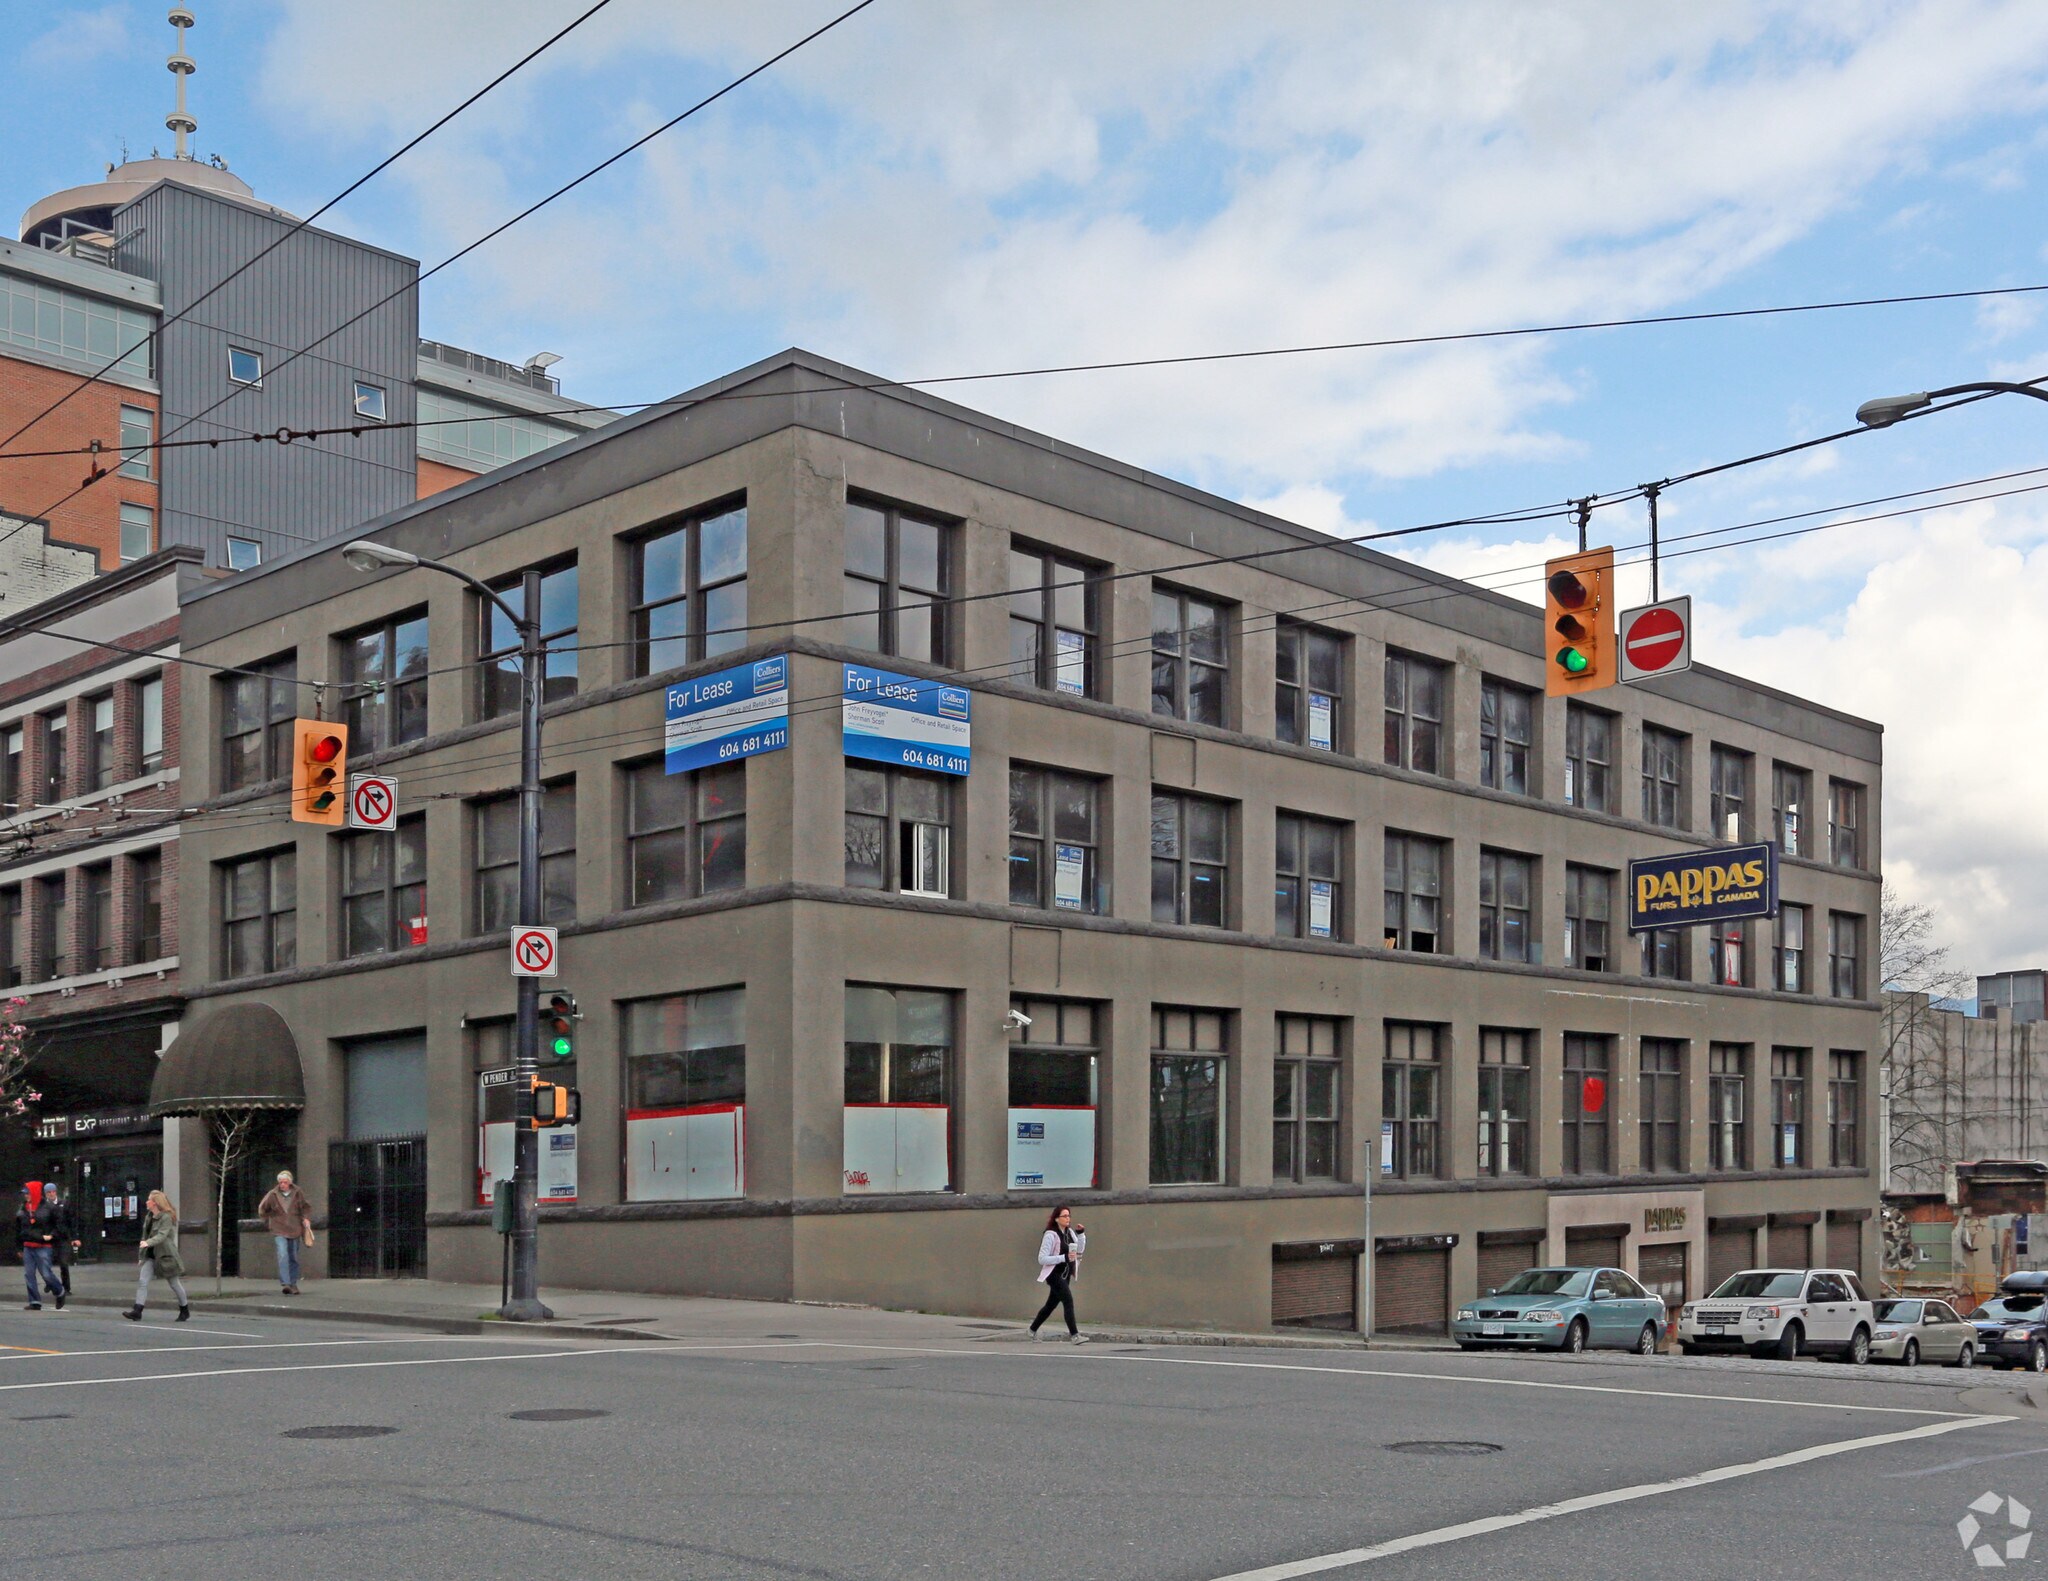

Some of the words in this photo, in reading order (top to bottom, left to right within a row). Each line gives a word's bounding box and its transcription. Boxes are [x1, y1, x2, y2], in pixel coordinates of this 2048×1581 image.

[757, 666, 781, 677] Colliers
[847, 670, 872, 692] For
[876, 676, 918, 702] Lease
[668, 690, 690, 710] For
[694, 681, 733, 703] Lease
[942, 691, 965, 704] Colliers
[726, 706, 741, 715] Office
[743, 703, 752, 711] and
[752, 700, 767, 709] Retail
[768, 696, 784, 706] Space
[847, 704, 860, 713] John
[847, 713, 871, 723] Sherman
[872, 717, 885, 726] Scott
[910, 716, 926, 725] Office
[927, 719, 937, 727] and
[937, 721, 951, 729] Retail
[952, 723, 967, 733] Space
[719, 742, 739, 758] 604
[742, 736, 760, 752] 681
[763, 730, 785, 746] 4111
[902, 749, 923, 764] 604
[926, 753, 944, 768] 681
[947, 757, 967, 772] 4111
[1637, 859, 1764, 913] PAPPAS
[1716, 890, 1760, 903] CANADA
[1650, 900, 1678, 911] FURS
[484, 1074, 489, 1084] W
[489, 1071, 508, 1083] PENDER
